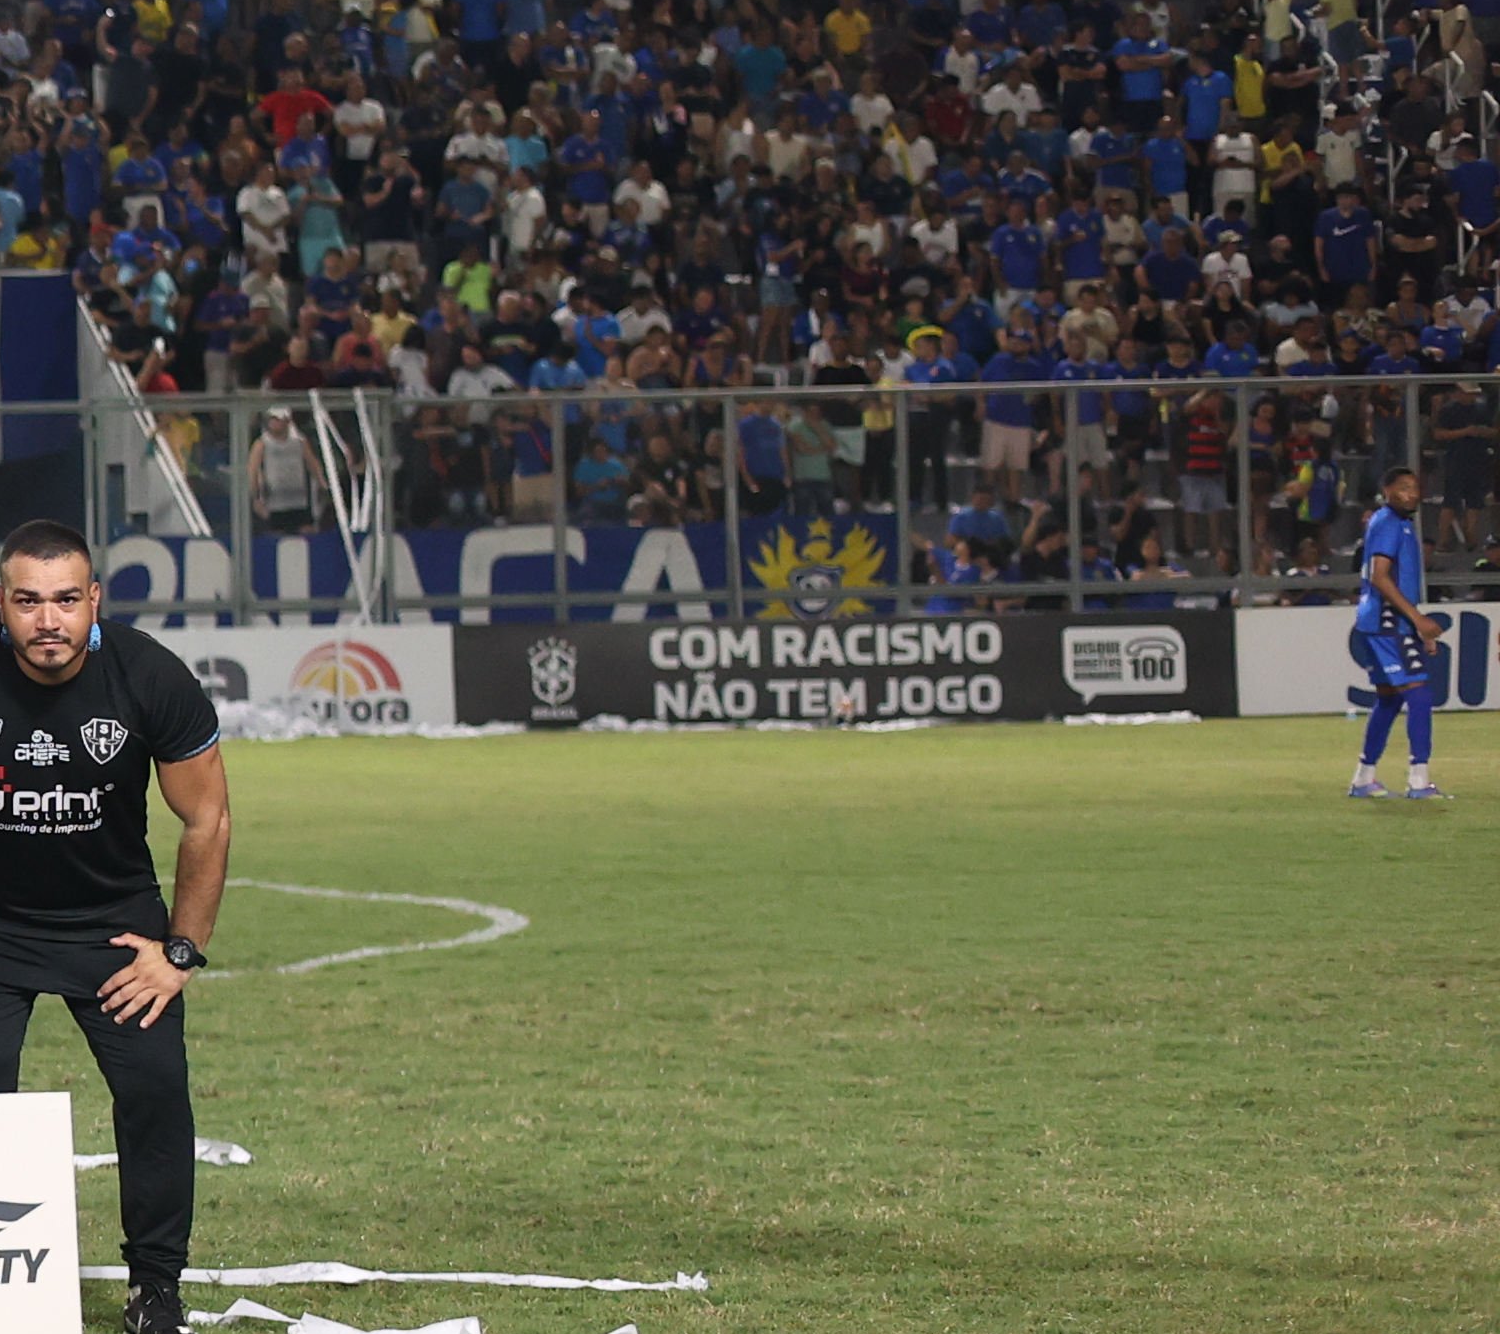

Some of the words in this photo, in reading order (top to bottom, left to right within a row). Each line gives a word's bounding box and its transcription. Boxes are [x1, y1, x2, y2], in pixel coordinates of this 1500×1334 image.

[650, 626, 761, 670] COM
[772, 620, 1003, 668] RACISMO
[1129, 657, 1177, 681] 100
[654, 670, 758, 720] NÃO
[766, 675, 867, 719] TEM
[877, 672, 1003, 716] JOGO
[15, 747, 71, 762] CHEFE
[21, 807, 101, 822] SOLUTIO
[39, 822, 53, 834] de
